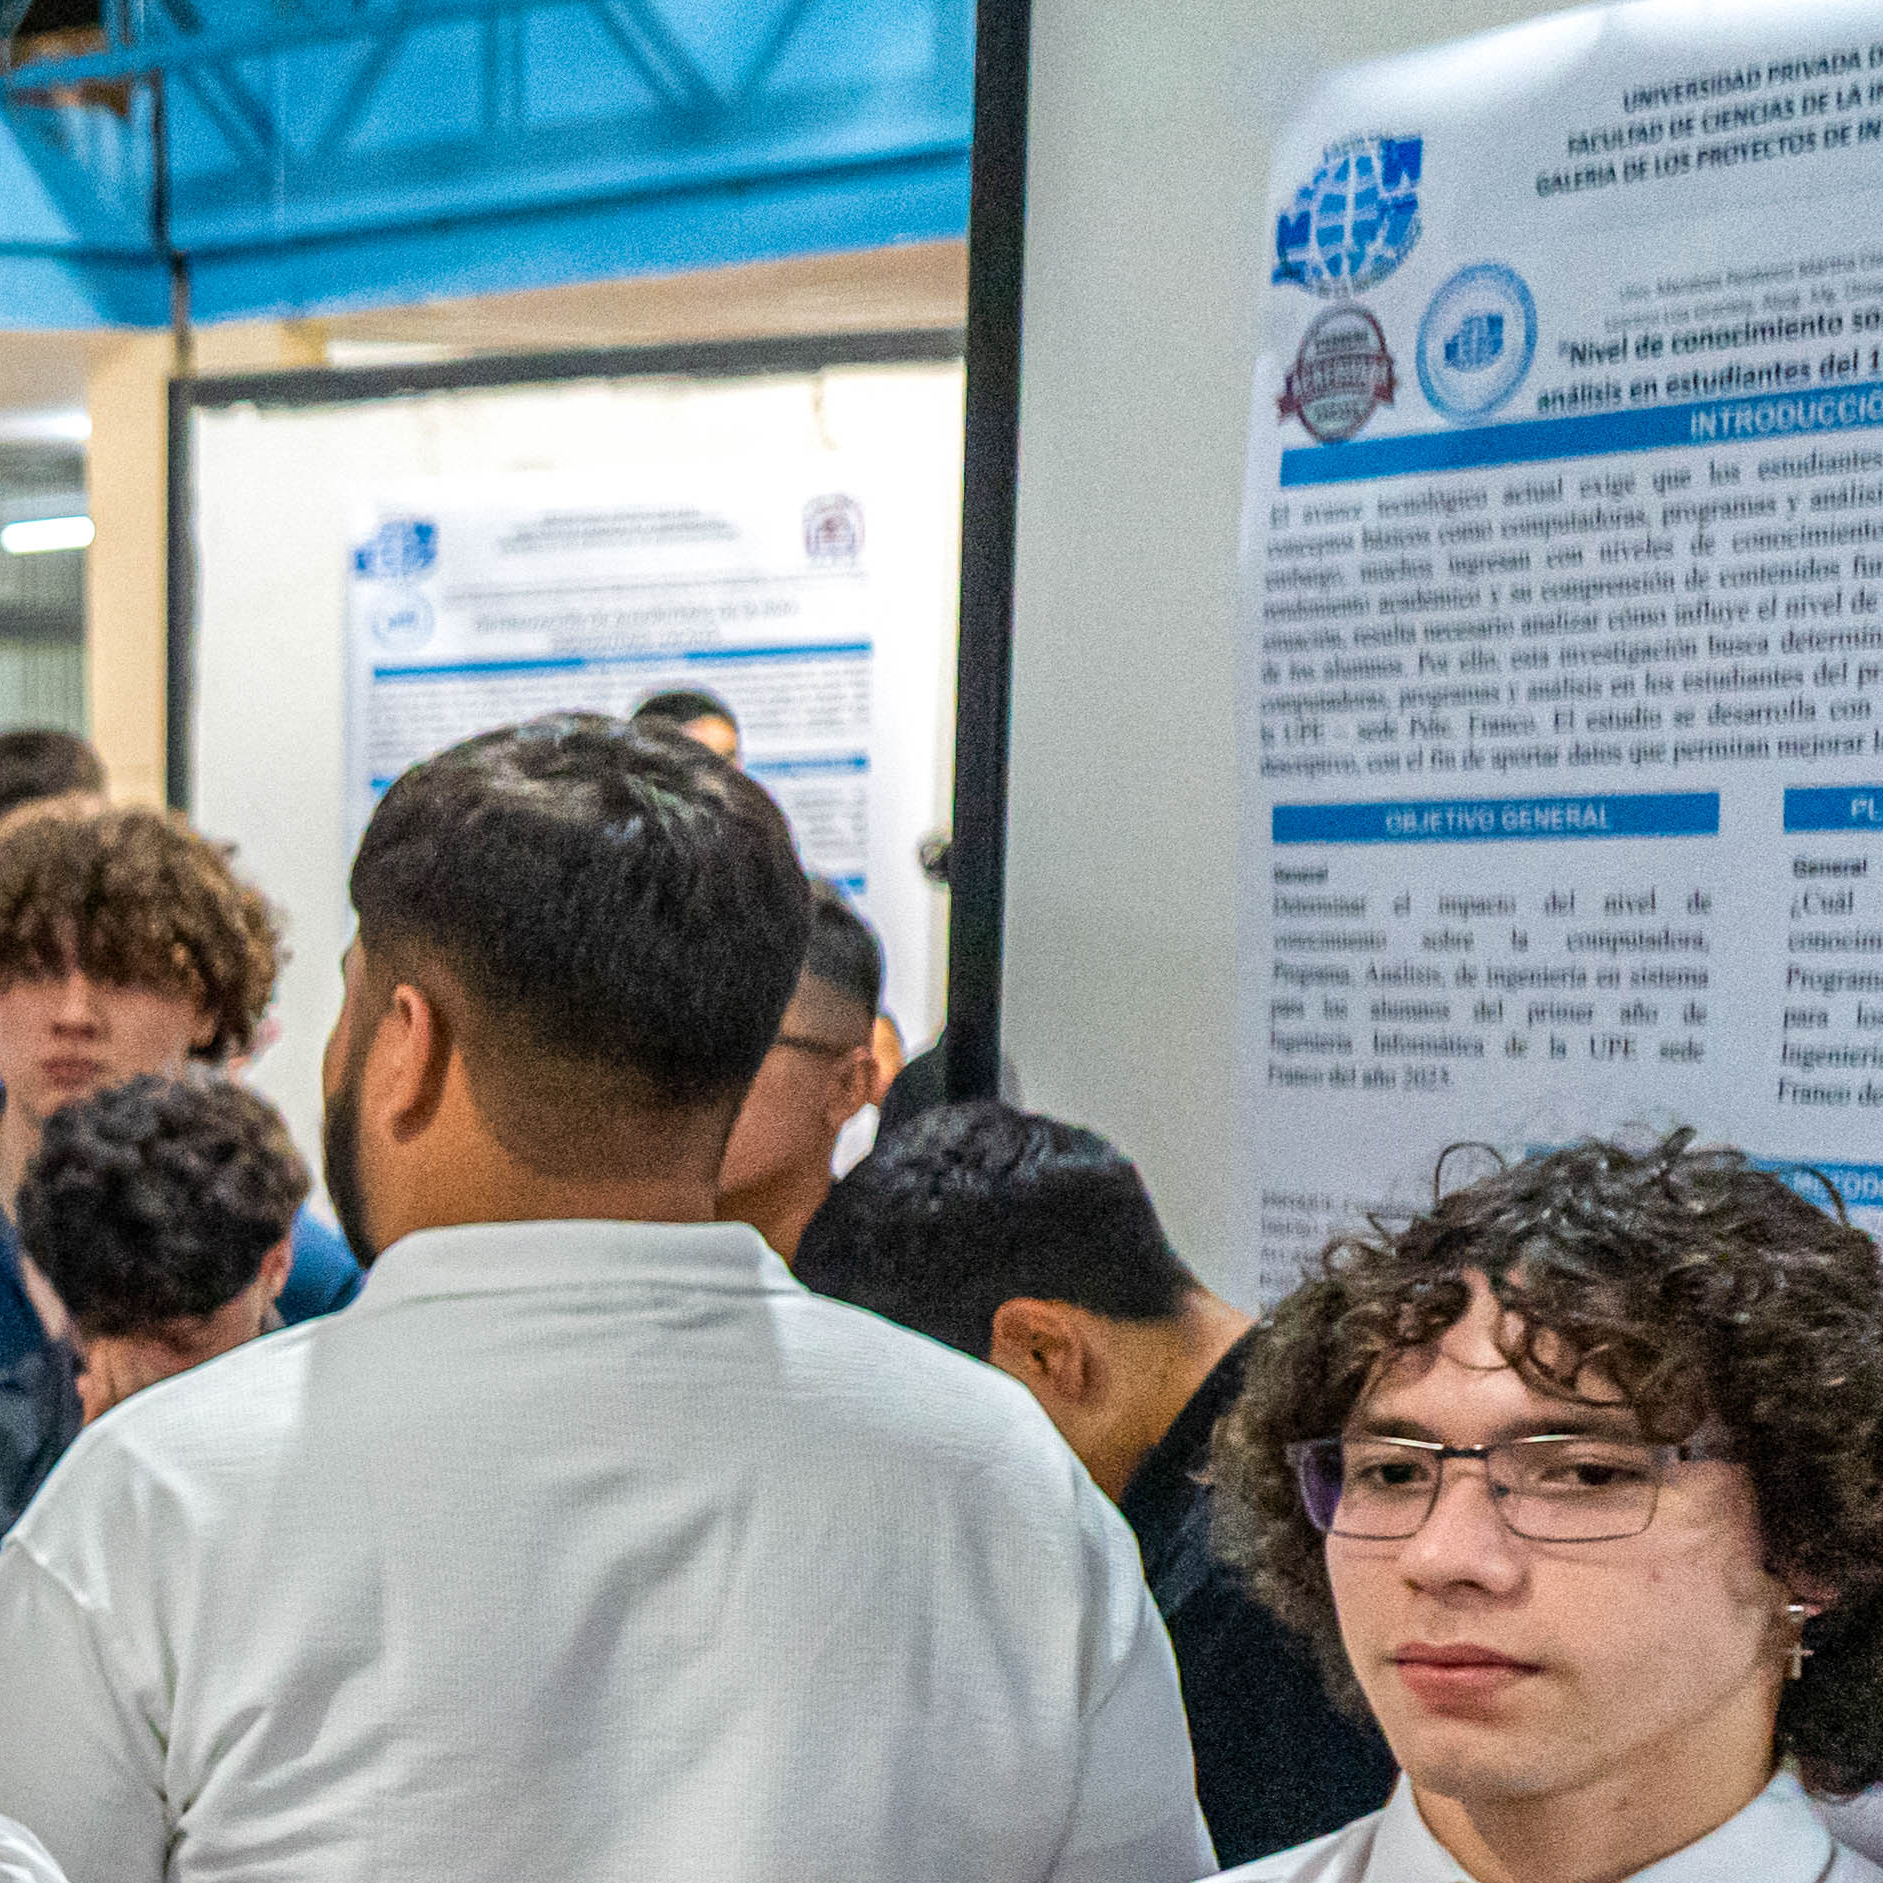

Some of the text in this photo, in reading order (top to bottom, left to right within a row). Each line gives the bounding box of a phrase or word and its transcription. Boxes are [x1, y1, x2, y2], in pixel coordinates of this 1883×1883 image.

[1623, 64, 1762, 114] UNIVERSIDAD
[1767, 46, 1862, 84] PRIVADA
[1567, 120, 1664, 157] FACULTAD
[1670, 116, 1695, 139] DE
[1702, 99, 1795, 135] CIENCIAS
[1801, 91, 1830, 117] DE
[1836, 84, 1862, 109] LA
[1623, 157, 1647, 183] DE
[1655, 151, 1690, 179] LOS
[1696, 132, 1816, 170] PROYECTOS
[1823, 123, 1852, 150] DE
[1635, 330, 1663, 360] de
[1671, 311, 1844, 351] conocimiento
[1537, 378, 1622, 410] análisis
[1629, 379, 1658, 400] en
[1665, 358, 1810, 395] estudiantes
[1820, 349, 1859, 377] del
[1580, 470, 1636, 500] exige
[1652, 471, 1692, 497] que
[1708, 461, 1740, 486] los
[1662, 496, 1777, 527] programas
[1786, 494, 1799, 517] y
[1546, 550, 1583, 569] con
[1599, 536, 1674, 564] niveles
[1690, 531, 1715, 556] de
[1540, 567, 1675, 603] comprensión
[1684, 564, 1710, 589] de
[1720, 556, 1841, 587] contenidos
[1608, 604, 1667, 631] cómo
[1674, 597, 1750, 626] influye
[1757, 593, 1777, 619] el
[1785, 589, 1842, 617] nivel
[1849, 588, 1878, 613] de
[1558, 635, 1698, 669] investigación
[1707, 633, 1769, 658] busca
[1525, 672, 1603, 700] análisis
[1609, 678, 1636, 696] en
[1644, 669, 1674, 694] los
[1681, 662, 1804, 692] estudiantes
[1812, 658, 1848, 685] del
[1553, 709, 1575, 733] El
[1586, 706, 1662, 732] estudio
[1673, 711, 1696, 728] se
[1707, 699, 1816, 727] desarrolla
[1829, 704, 1871, 722] con
[1568, 743, 1623, 766] datos
[1629, 744, 1667, 768] que
[1673, 734, 1770, 765] permitan
[1777, 735, 1864, 759] mejorar
[1385, 803, 1610, 837] OBJETIVO GENERAL
[1792, 856, 1868, 880] General
[1393, 892, 1411, 917] el
[1437, 894, 1516, 922] impacto
[1544, 888, 1576, 917] del
[1604, 886, 1657, 916] nivel
[1686, 889, 1713, 916] de
[1790, 888, 1854, 919] ¿Cuál
[1511, 924, 1529, 951] la
[1566, 926, 1710, 957] computadora,
[1454, 963, 1478, 988] de
[1595, 967, 1622, 989] en
[1630, 966, 1710, 990] sistema
[1472, 999, 1504, 1023] del
[1527, 1002, 1594, 1029] primer
[1619, 1000, 1658, 1026] año
[1681, 1000, 1708, 1026] de
[1784, 1004, 1830, 1034] para
[1372, 1030, 1485, 1058] Informática
[1504, 1029, 1529, 1058] de
[1549, 1033, 1567, 1060] la
[1589, 1034, 1637, 1061] UPE
[1658, 1038, 1704, 1063] sede
[1777, 1073, 1851, 1104] Franco
